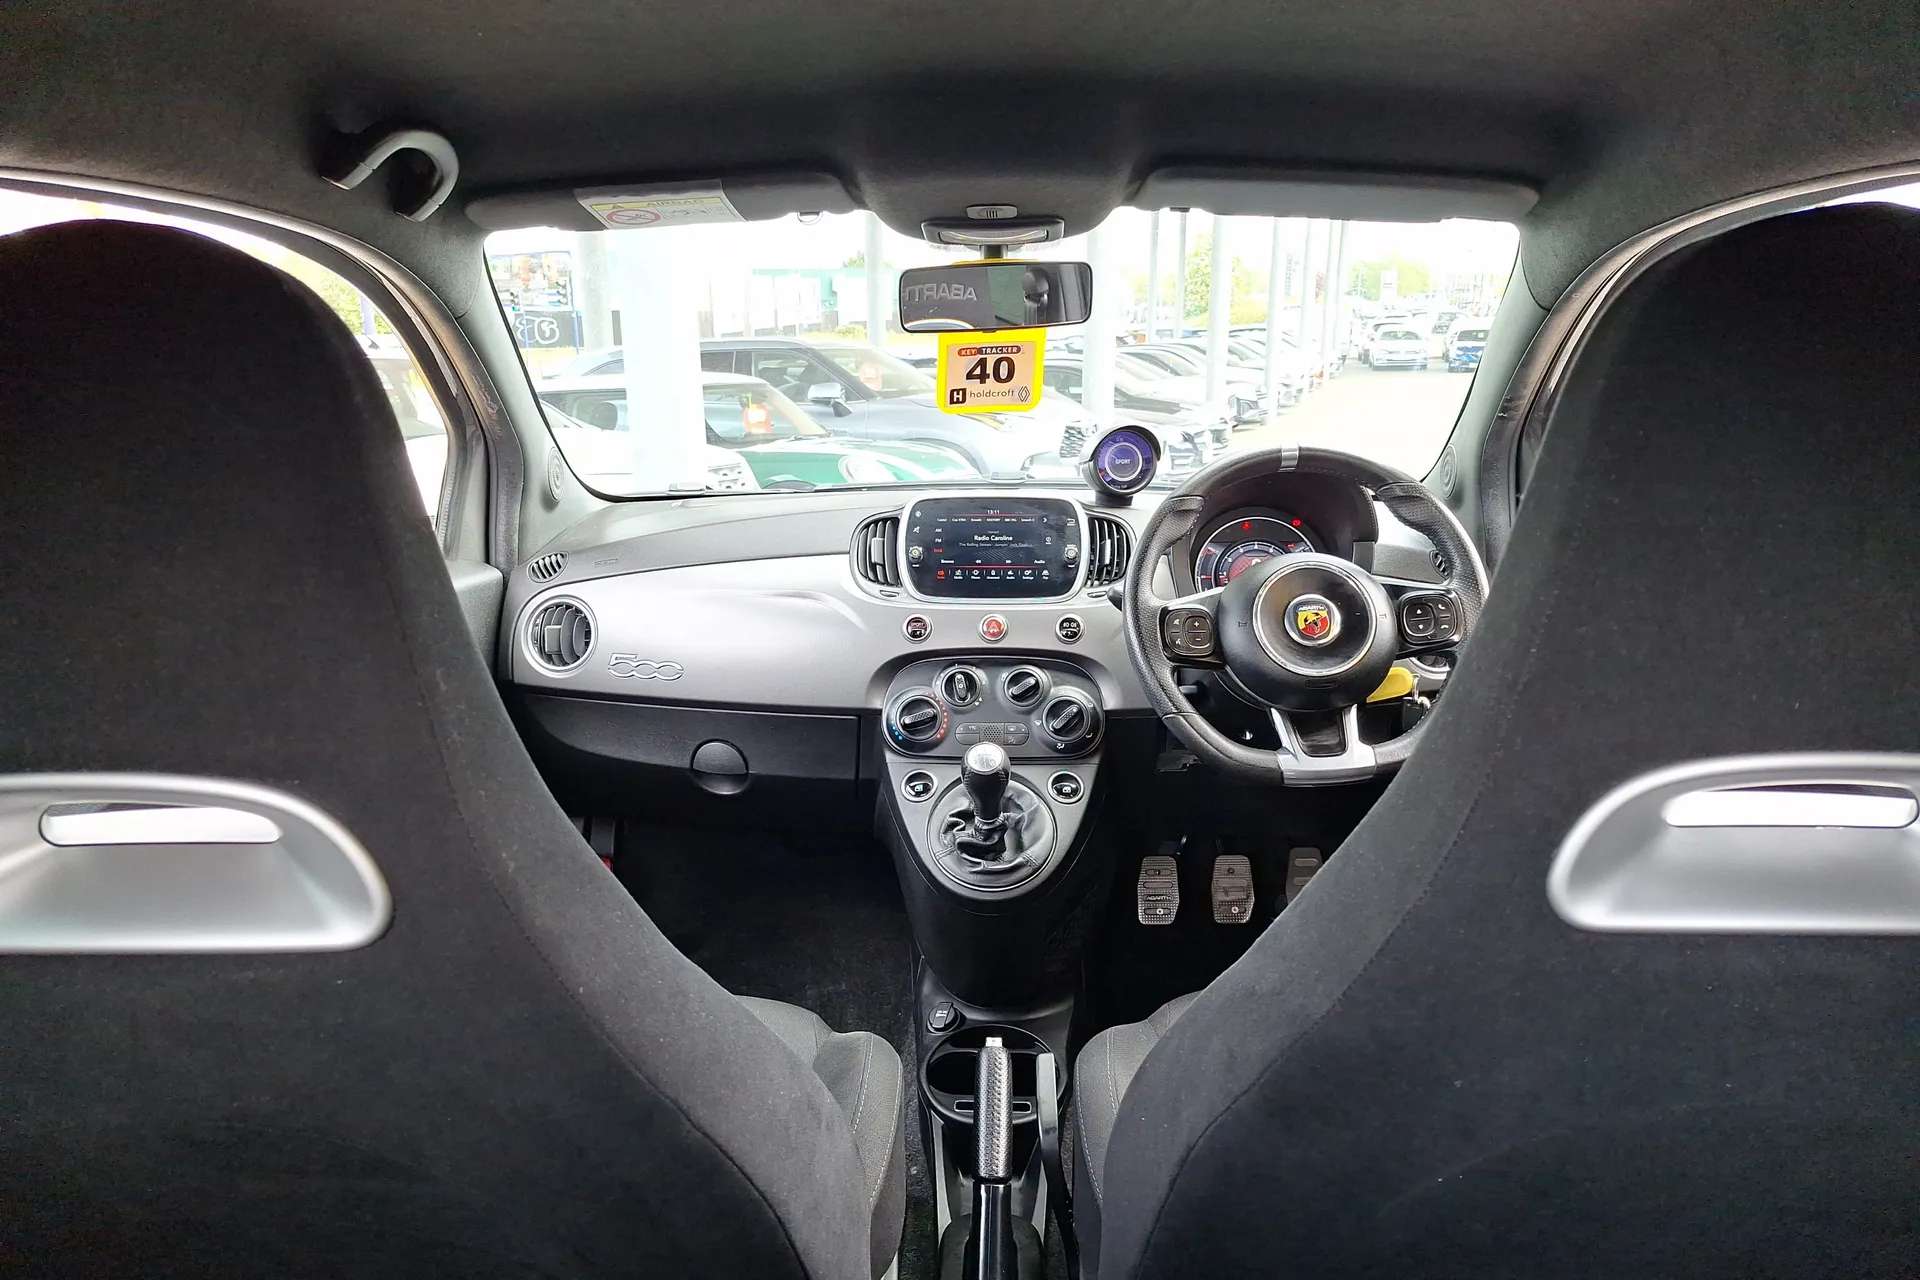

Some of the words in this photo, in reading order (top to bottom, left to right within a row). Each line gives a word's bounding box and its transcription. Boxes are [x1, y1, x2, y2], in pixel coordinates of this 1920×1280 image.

[981, 346, 1018, 354] TRACKER
[966, 357, 1015, 384] 40
[969, 388, 1014, 399] holdcroft
[608, 653, 684, 681] 500
